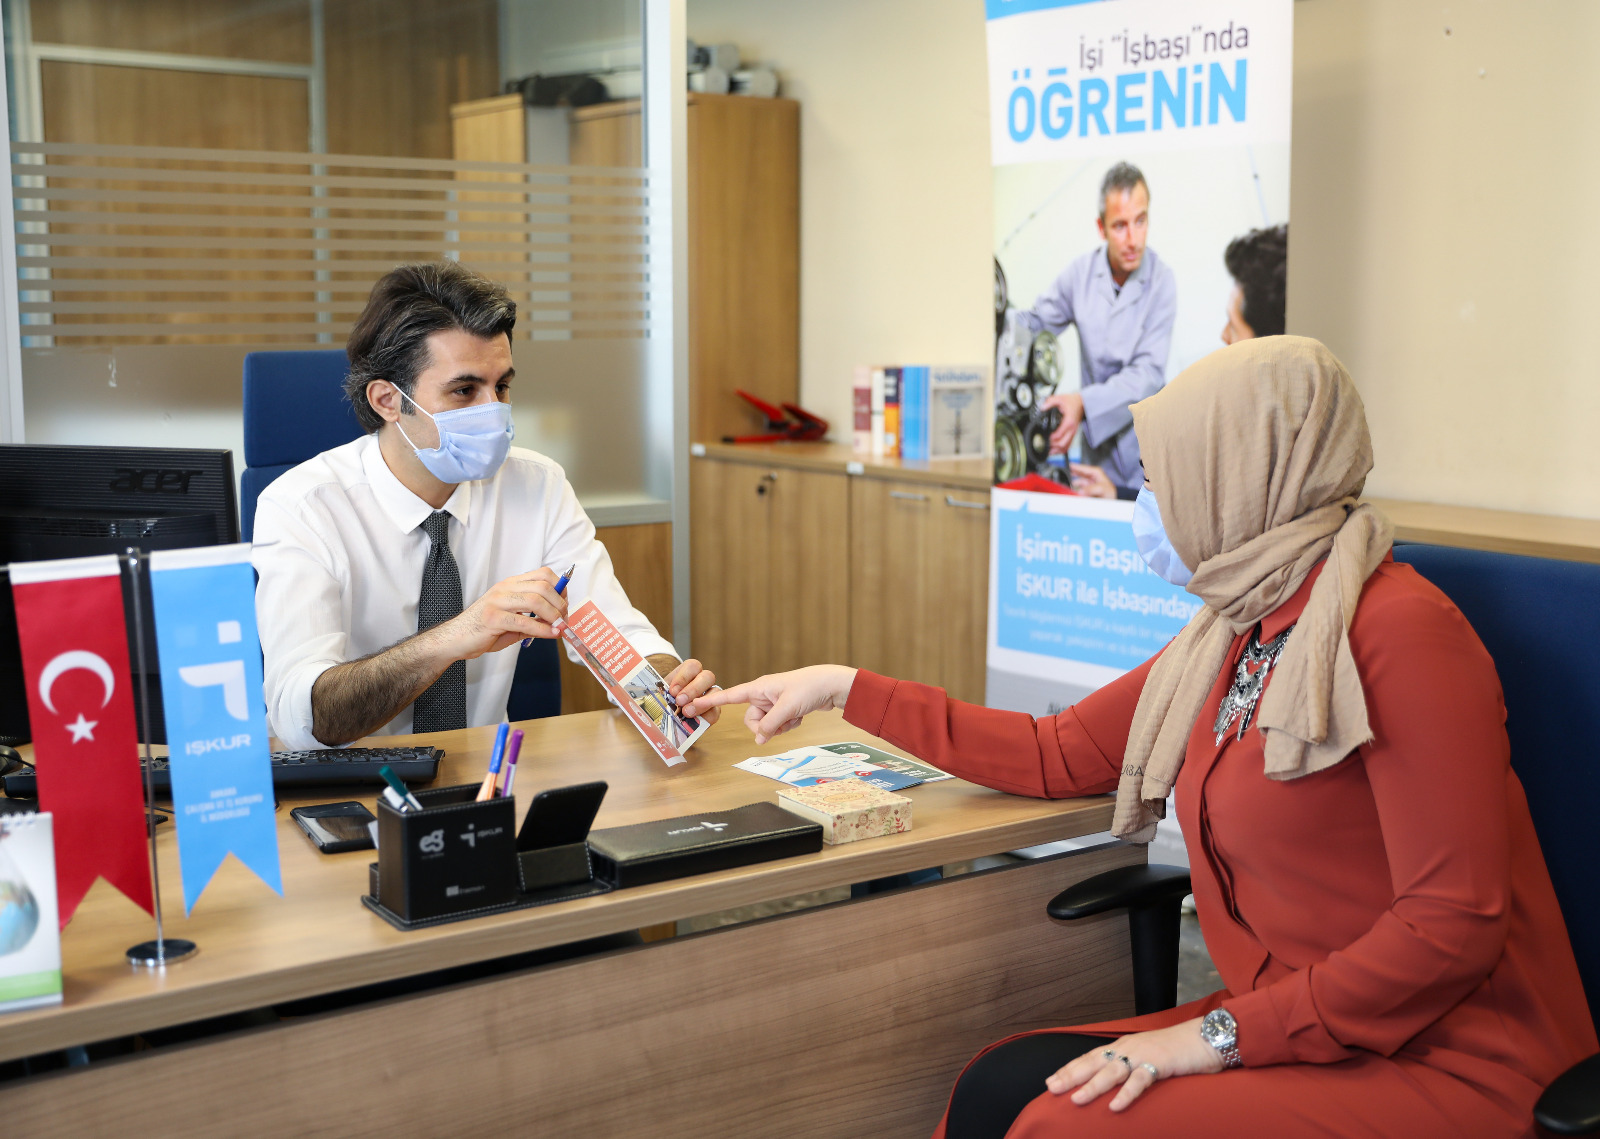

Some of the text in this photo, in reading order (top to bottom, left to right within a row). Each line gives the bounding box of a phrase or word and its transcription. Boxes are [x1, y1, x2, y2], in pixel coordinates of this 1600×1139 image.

[1079, 35, 1104, 72] İşi
[108, 468, 203, 495] acer
[1016, 523, 1083, 566] İşimin
[1016, 567, 1073, 600] İŞKUR
[1076, 580, 1099, 606] ile
